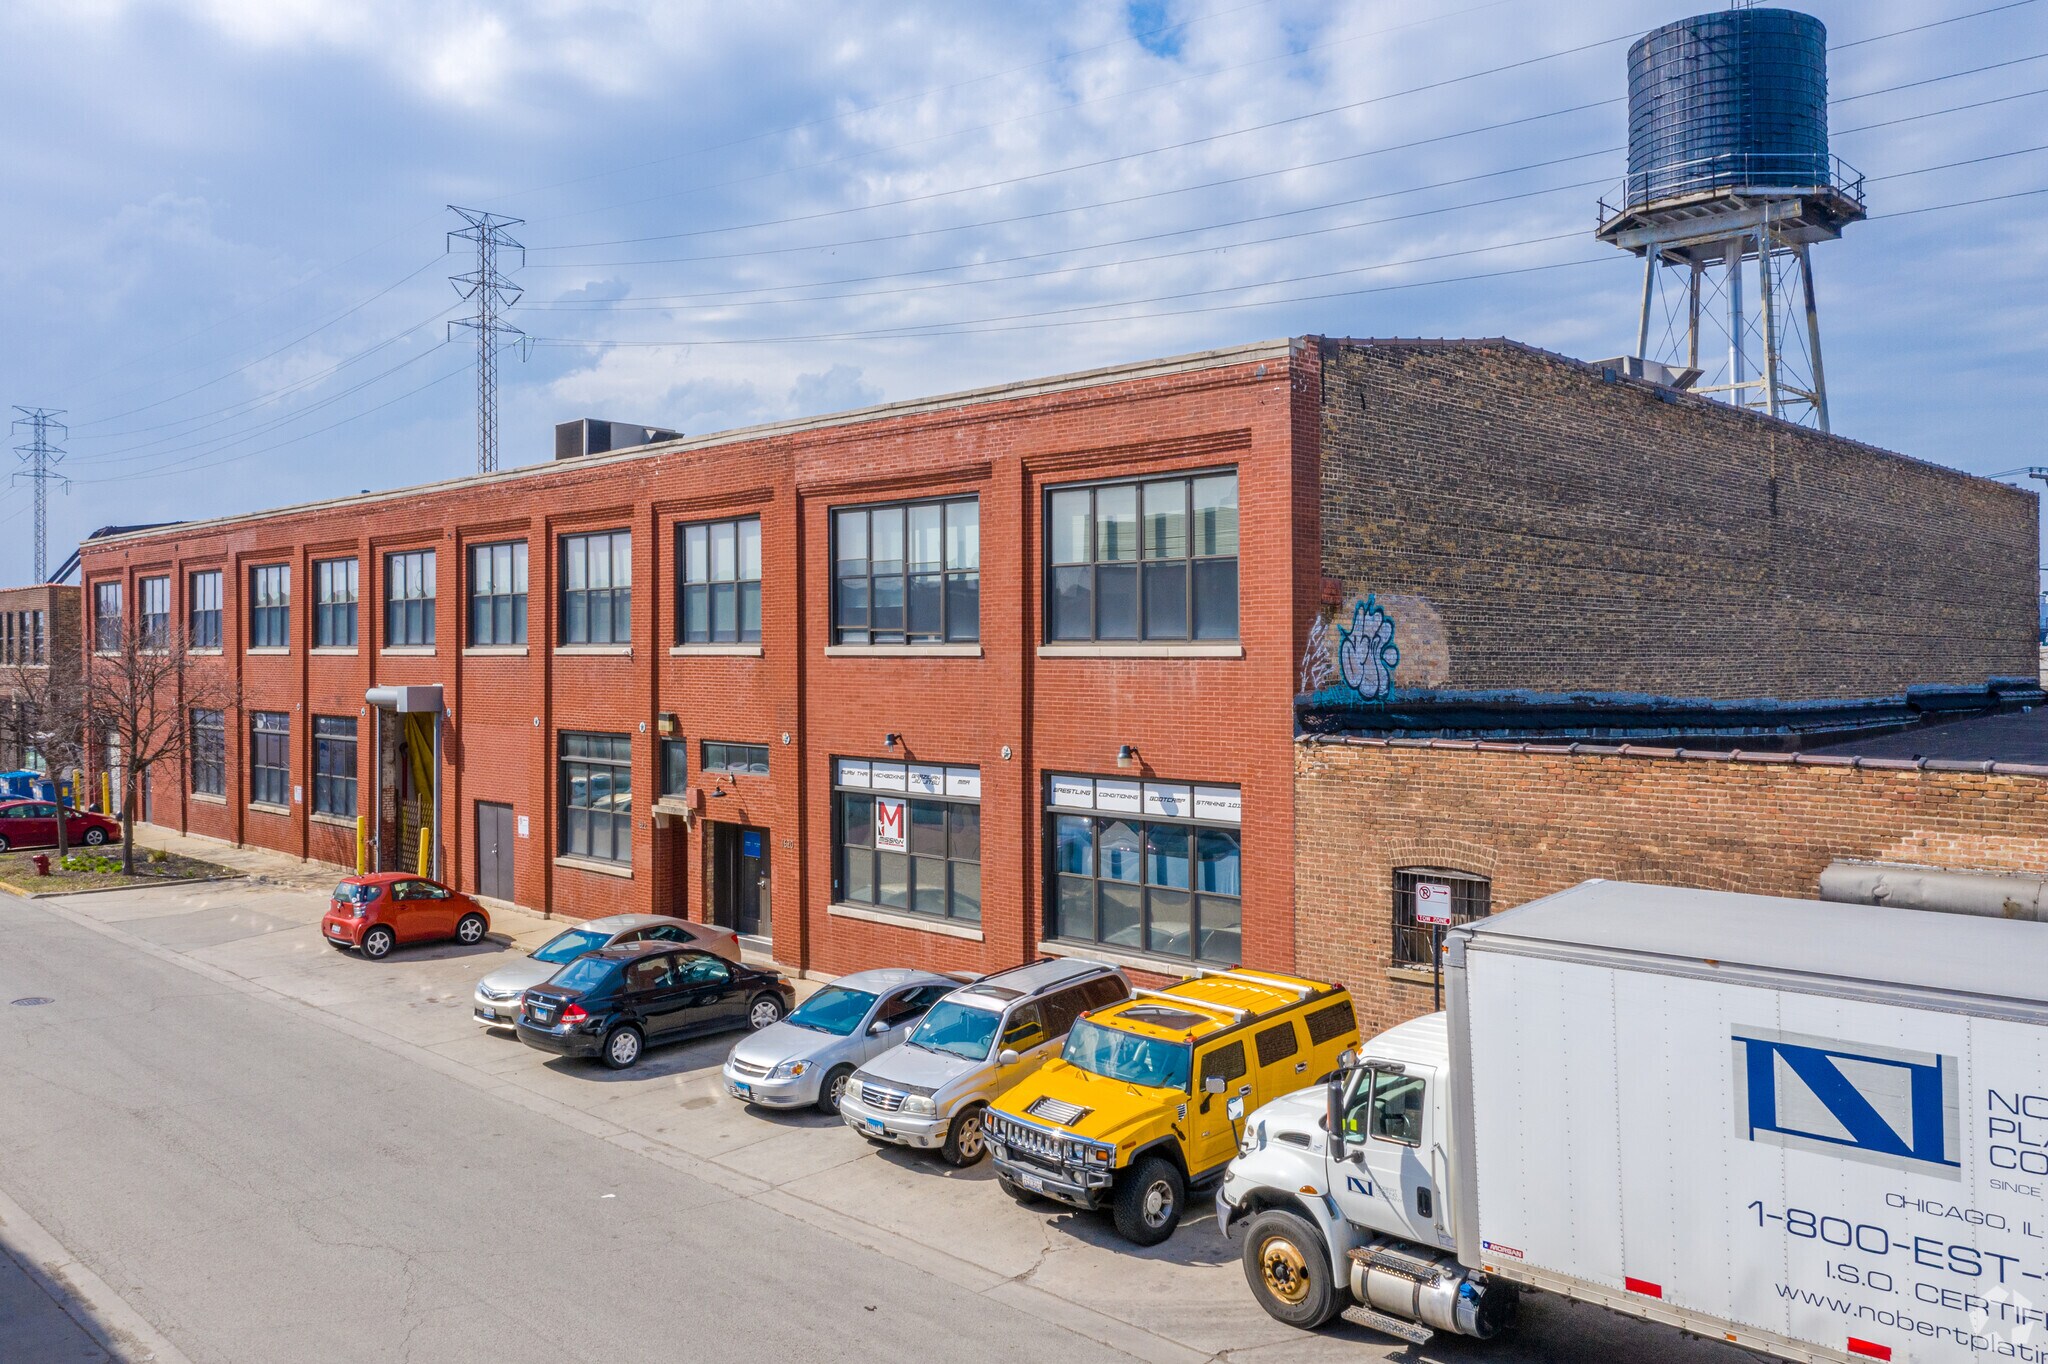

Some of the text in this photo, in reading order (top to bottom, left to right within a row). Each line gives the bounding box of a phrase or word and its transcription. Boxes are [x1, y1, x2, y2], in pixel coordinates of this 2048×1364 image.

[873, 772, 905, 780] KICKBOXING
[1053, 787, 1091, 796] WRESTLING
[1098, 792, 1139, 800] CONDITIONING
[1195, 800, 1226, 808] STRIKING
[878, 801, 904, 838] M
[878, 837, 904, 845] MISSION
[1989, 1117, 2048, 1148] PL
[1990, 1145, 2048, 1175] CO
[1990, 1179, 2041, 1197] SINCE
[1886, 1193, 2043, 1239] CHICAGO, IL
[1490, 1243, 1522, 1258] MORGAN
[1748, 1200, 2048, 1284] 1-800-EST-
[1826, 1260, 1899, 1295] I.S.O.
